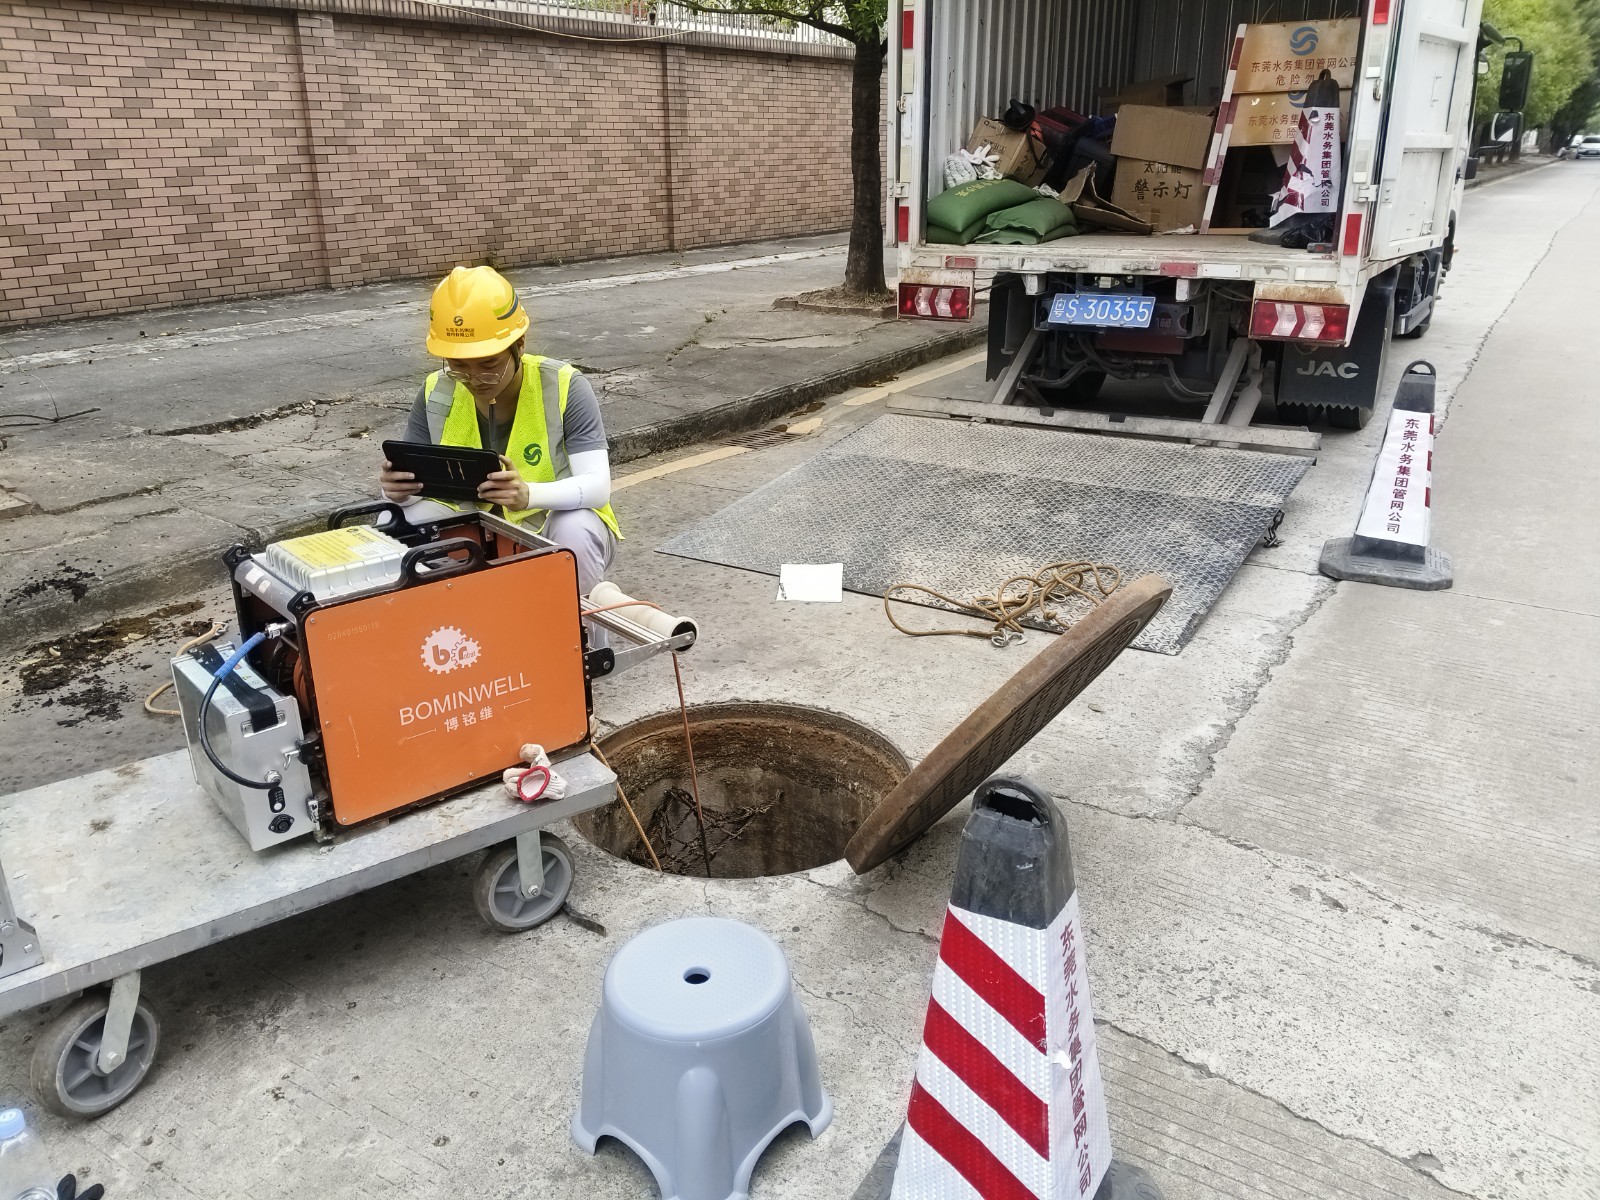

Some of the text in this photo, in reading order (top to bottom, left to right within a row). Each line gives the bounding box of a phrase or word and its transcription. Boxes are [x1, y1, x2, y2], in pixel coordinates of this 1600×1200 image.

[1250, 57, 1356, 73] 东莞水务集团管网公司
[1131, 178, 1193, 201] 警示灯
[1296, 360, 1360, 379] JAC
[1386, 418, 1420, 534] 东莞水务集团管网公司
[399, 671, 531, 726] BOMINWELL
[444, 705, 493, 733] 博铭维
[1060, 919, 1091, 1197] 东莞水务集团管网公司
